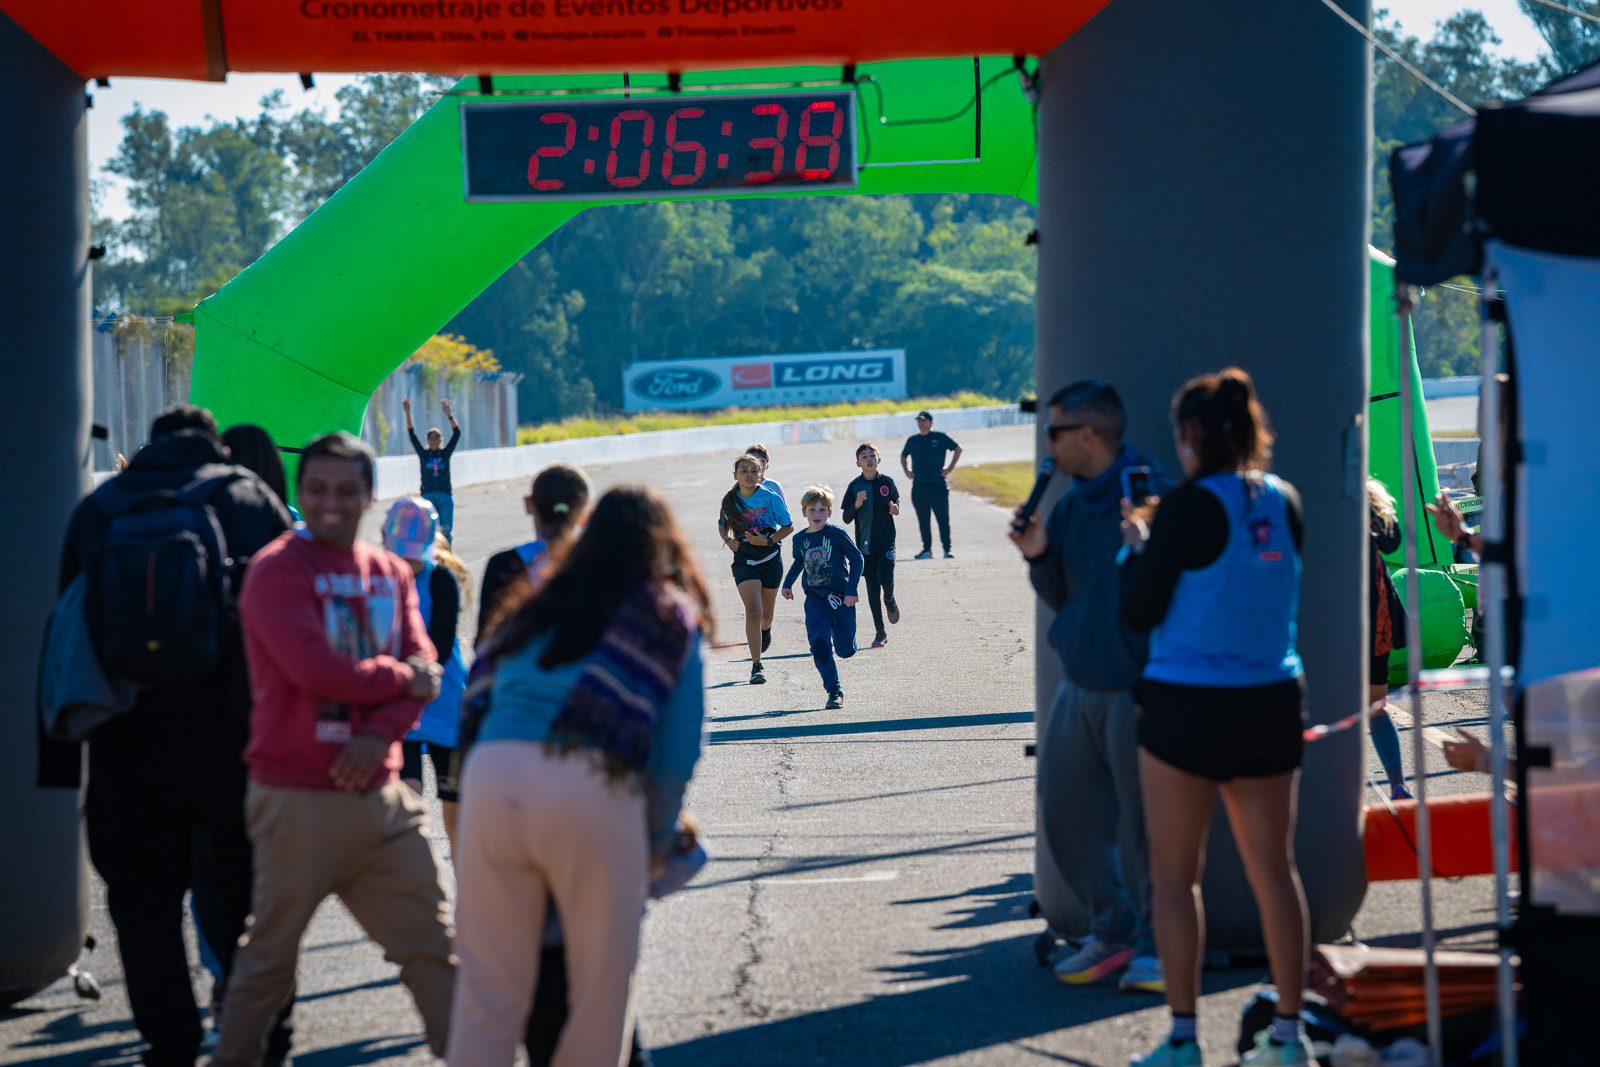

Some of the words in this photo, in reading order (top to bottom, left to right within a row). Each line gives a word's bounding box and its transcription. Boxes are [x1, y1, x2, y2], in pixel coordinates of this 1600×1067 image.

[301, 0, 500, 22] Cronometraje
[509, 0, 546, 18] de
[555, 0, 671, 17] Eventos
[527, 101, 844, 190] 2:06:38
[648, 370, 704, 397] Ford
[782, 362, 885, 384] LONG
